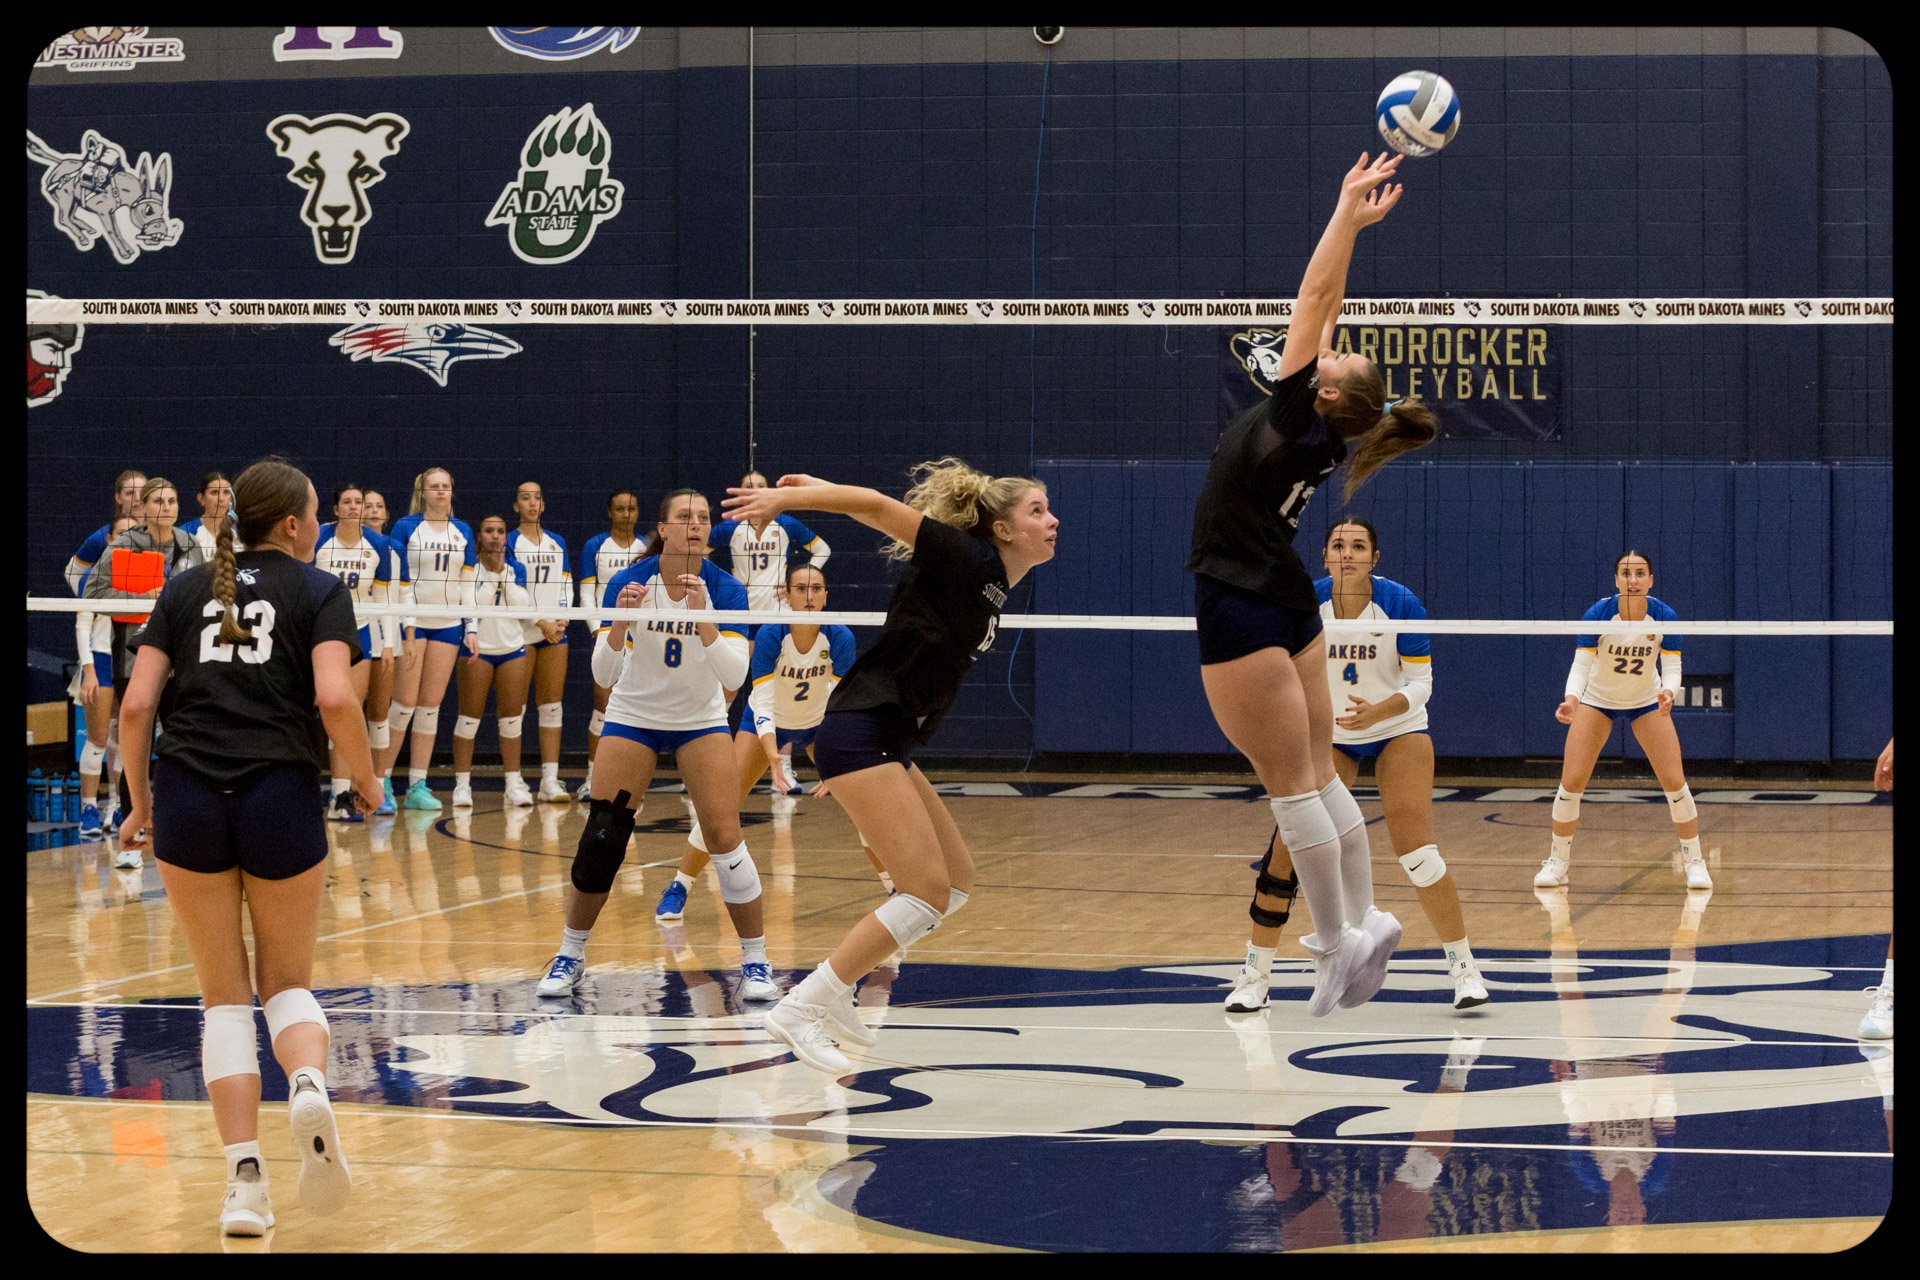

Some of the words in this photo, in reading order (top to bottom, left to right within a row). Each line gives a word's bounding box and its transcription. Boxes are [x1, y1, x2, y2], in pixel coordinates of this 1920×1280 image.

[70, 60, 133, 69] GRIFFINS
[498, 185, 618, 216] ADAMS
[528, 215, 579, 231] STATE
[82, 302, 117, 316] SOUTH
[120, 302, 162, 316] DAKOTA
[165, 302, 198, 316] MINES
[229, 302, 264, 316] SOUTH
[267, 302, 309, 316] DAKOTA
[312, 302, 346, 316] MINES
[378, 302, 414, 316] SOUTH
[417, 302, 460, 316] DAKOTA
[463, 302, 498, 316] MINES
[530, 302, 567, 316] SOUTH
[570, 302, 614, 316] DAKOTA
[617, 302, 652, 316] MINES
[685, 302, 722, 316] SOUTH
[726, 302, 771, 316] DAKOTA
[774, 302, 809, 316] MINES
[843, 302, 880, 316] SOUTH
[884, 302, 929, 316] DAKOTA
[932, 302, 967, 316] MINES
[1002, 302, 1040, 316] SOUTH
[1044, 302, 1090, 316] DAKOTA
[1093, 302, 1129, 316] MINES
[1164, 302, 1202, 316] SOUTH
[1206, 302, 1252, 316] DAKOTA
[1255, 302, 1291, 316] MINES
[1340, 302, 1366, 316] UTH
[1369, 302, 1414, 316] DAKOTA
[1418, 302, 1454, 316] MINES
[1490, 302, 1529, 316] SOUTH
[1533, 302, 1579, 316] DAKOTA
[1583, 302, 1619, 316] MINES
[1655, 302, 1694, 316] SOUTH
[1698, 302, 1745, 316] DAKOTA
[1748, 302, 1785, 316] MINES
[1821, 302, 1860, 316] SOUTH
[1864, 302, 1894, 316] DAKO
[1335, 327, 1548, 366] ARDROCKER
[1385, 367, 1548, 400] LEYBALL
[424, 541, 458, 552] LAKERS
[742, 541, 776, 551] LAKERS
[330, 560, 367, 570] LAKERS
[434, 552, 450, 572] 11
[526, 554, 556, 564] LAKERS
[751, 552, 769, 571] 13
[338, 571, 360, 590] 18
[535, 565, 550, 584] 17
[199, 599, 276, 665] 23
[646, 620, 702, 637] LAKERS
[976, 614, 998, 652] 15
[664, 637, 683, 669] 8
[1328, 643, 1378, 660] AKERS
[1608, 644, 1653, 657] LAKERS
[781, 664, 827, 681] LAKERS
[1613, 657, 1645, 676] 22
[1342, 662, 1359, 686] 4
[793, 681, 810, 703] 2
